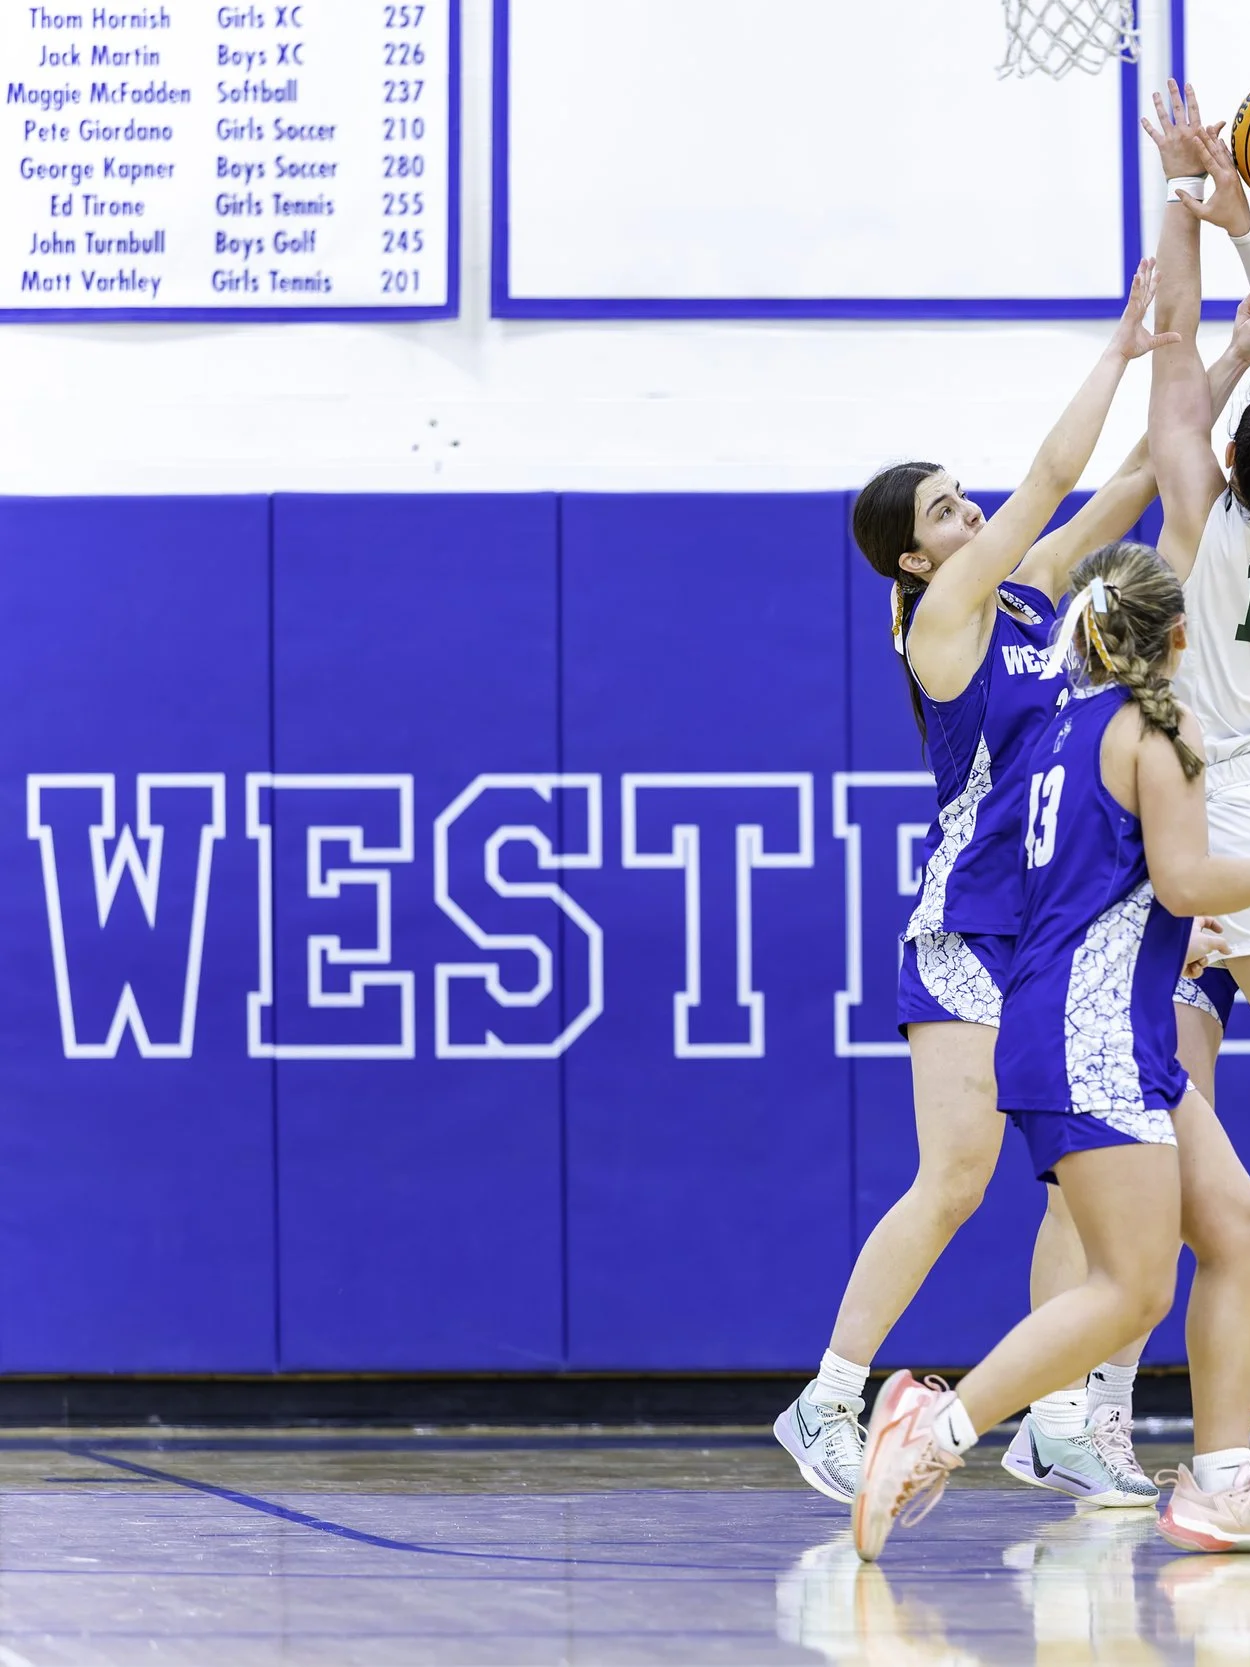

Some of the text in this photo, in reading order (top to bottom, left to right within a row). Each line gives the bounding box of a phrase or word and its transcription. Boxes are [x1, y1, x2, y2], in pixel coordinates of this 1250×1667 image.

[29, 5, 425, 29] Thom Hornish Girls XC 257
[39, 42, 425, 72] Jack Martin Boys XC 226
[7, 79, 424, 111] Maggie McFadden Softball 237
[25, 117, 424, 142] Pete Giordano Girls Soccer 210
[20, 155, 424, 186] George Kapner Boys Soccer 280
[51, 192, 424, 217] Ed Tirone Girls Tennis 255
[30, 230, 423, 261] John Turnbull Boys Golf 245
[21, 270, 71, 292] Matt
[212, 269, 259, 292] Girls
[268, 270, 332, 293] Tennis
[381, 270, 419, 293] 201
[1025, 765, 1066, 870] 13
